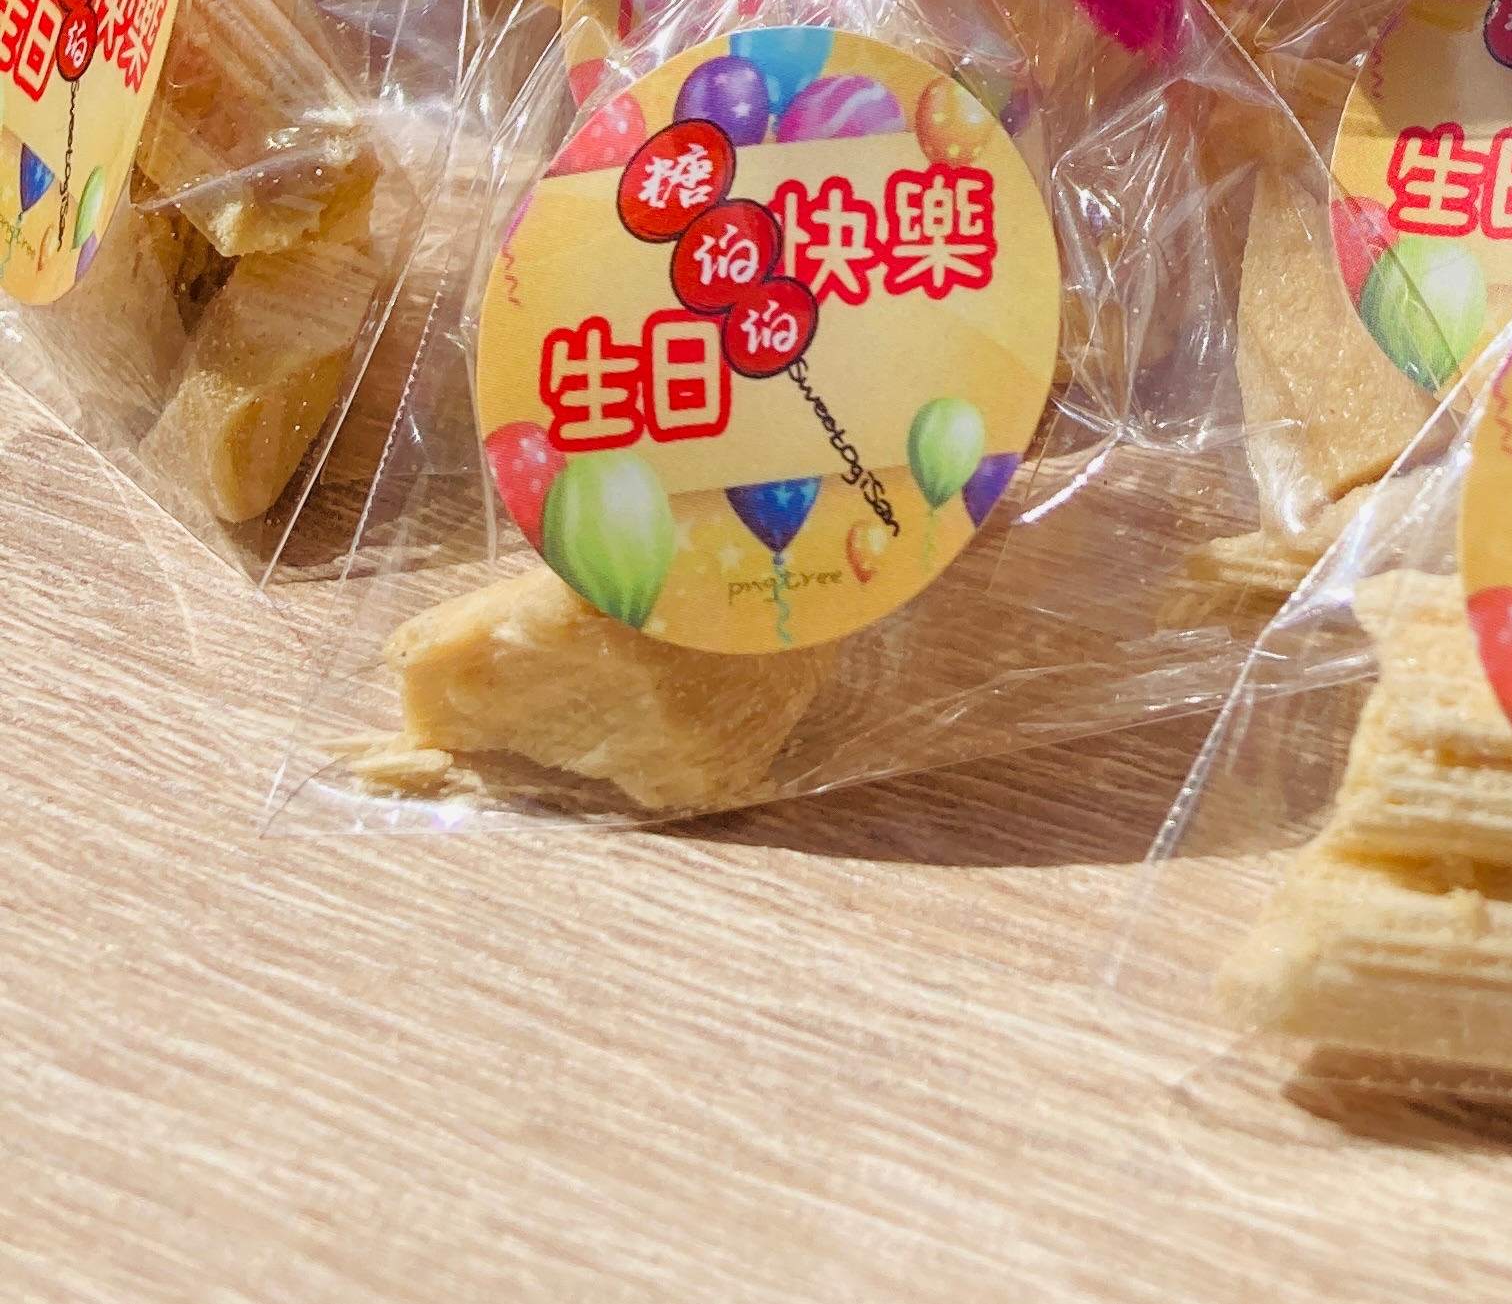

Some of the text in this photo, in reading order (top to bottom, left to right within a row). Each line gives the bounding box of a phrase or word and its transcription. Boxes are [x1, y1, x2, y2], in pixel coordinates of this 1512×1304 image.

[540, 164, 998, 455] 生日 快樂
[640, 144, 800, 353] 糖伯伯
